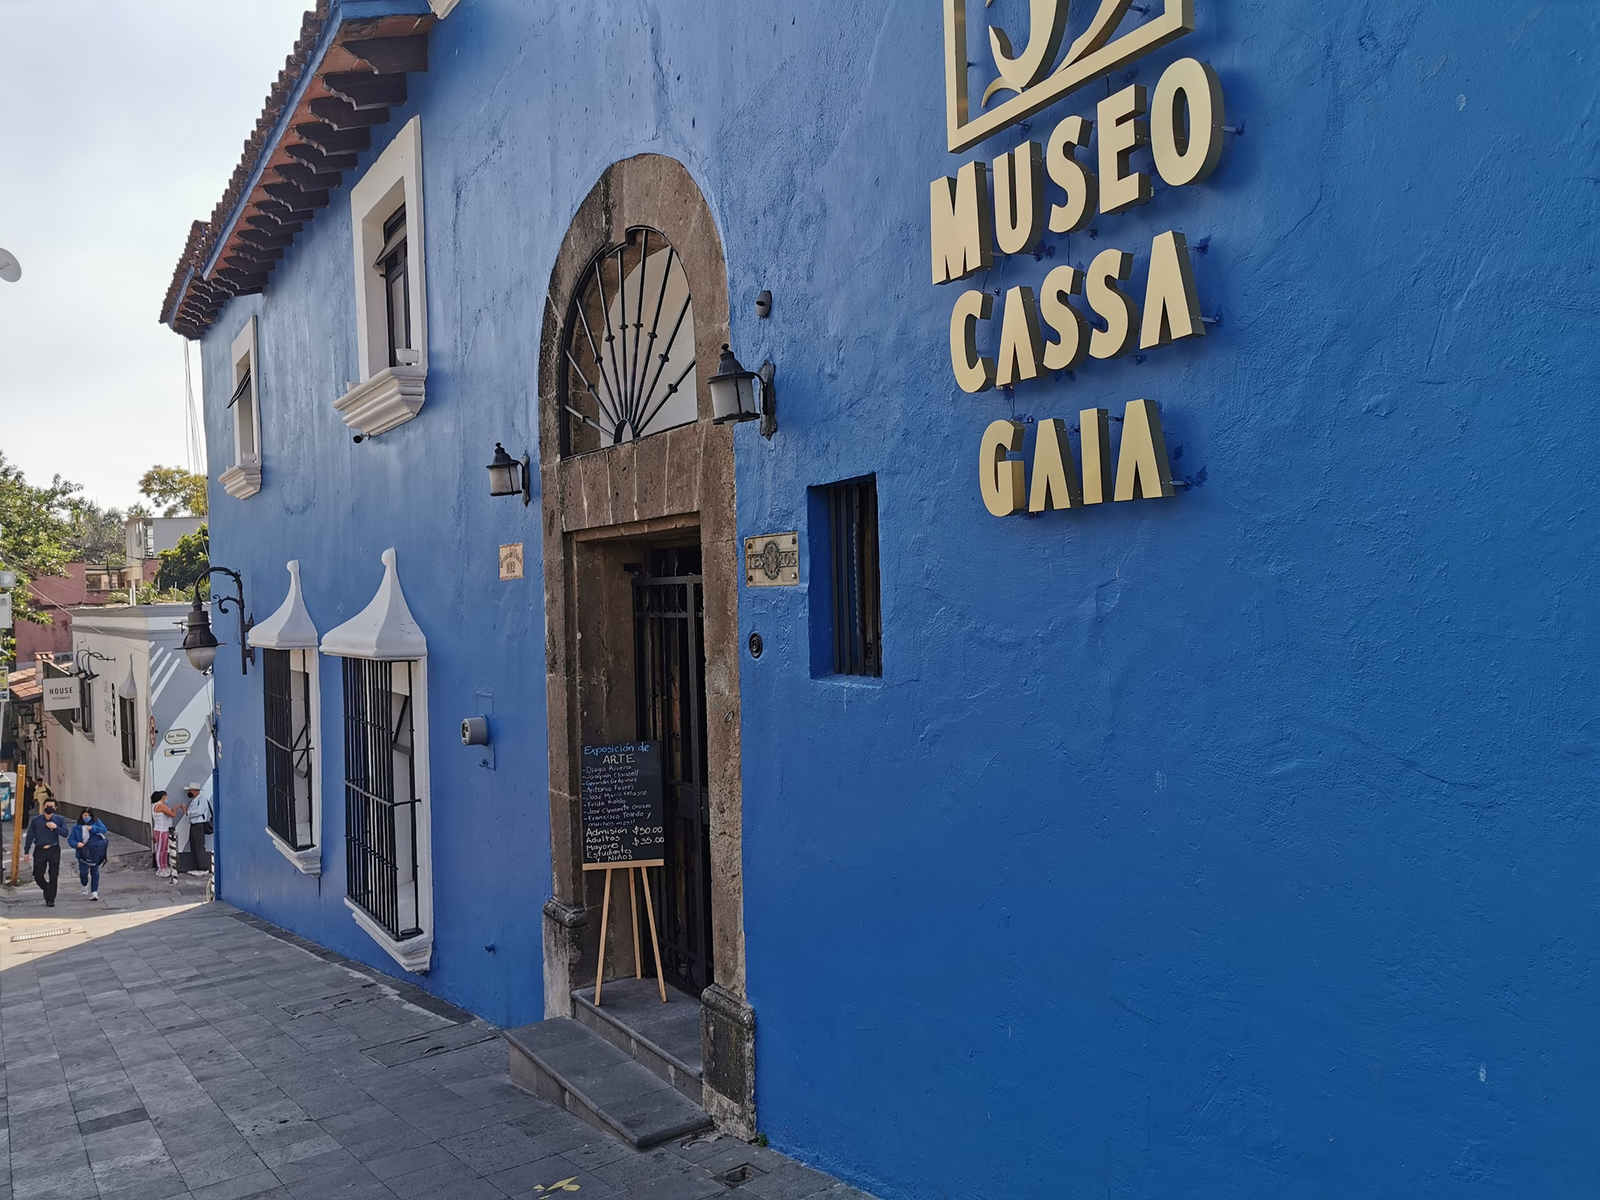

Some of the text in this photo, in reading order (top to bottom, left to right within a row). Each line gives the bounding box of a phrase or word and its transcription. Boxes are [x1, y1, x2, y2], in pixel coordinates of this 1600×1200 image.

[930, 57, 1223, 285] MUSEO
[949, 230, 1205, 393] CASSA
[979, 398, 1175, 517] GAIA
[49, 687, 73, 695] HOUSE
[584, 741, 650, 757] Exposición de
[602, 754, 635, 765] ARTE
[632, 825, 663, 836] $50.00
[586, 835, 621, 844] Adultos
